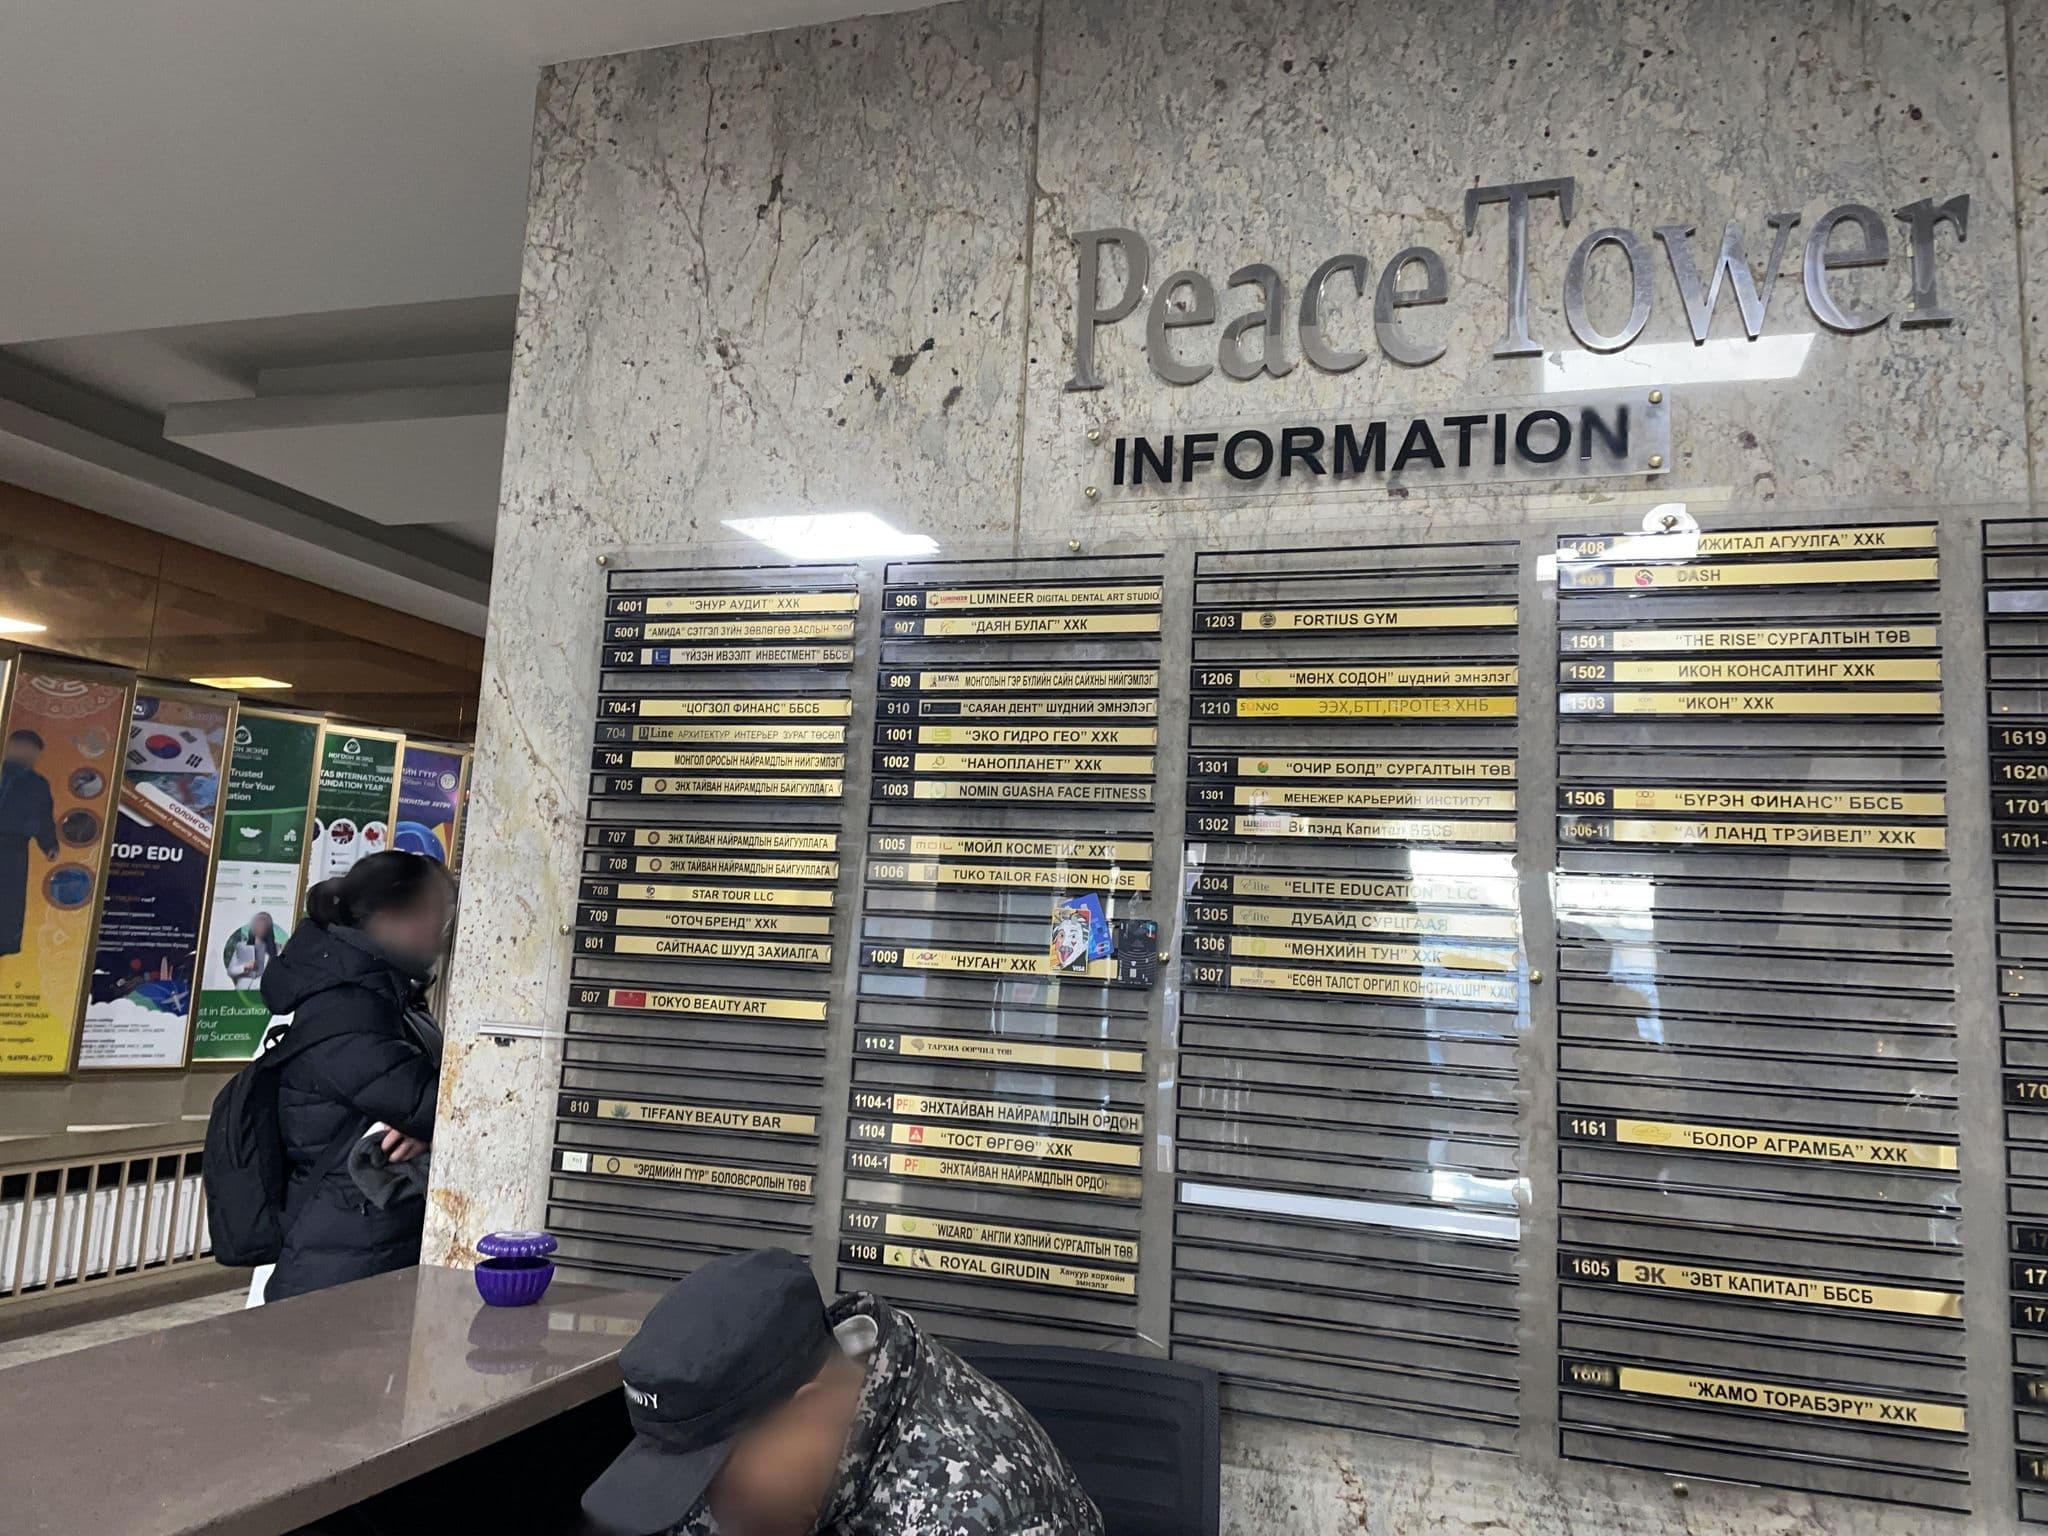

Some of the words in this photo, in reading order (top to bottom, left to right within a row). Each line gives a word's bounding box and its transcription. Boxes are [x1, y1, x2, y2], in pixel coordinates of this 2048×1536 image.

[1064, 229, 1449, 392] Peace
[1465, 177, 1970, 360] Tower
[1112, 405, 1631, 486] INFORMATION
[1853, 532, 1885, 546] ХХК
[1678, 570, 1720, 582] DASH
[617, 601, 642, 611] 4001
[777, 599, 800, 608] ХХК
[896, 595, 917, 606] 906
[970, 592, 1034, 604] LUMINEER
[1036, 594, 1068, 602] DIGITAL
[1106, 593, 1124, 601] ART
[1127, 592, 1159, 600] STUDIO
[1064, 619, 1087, 630] ХХК
[1205, 616, 1234, 627] 1203
[1294, 614, 1359, 626] FORTIUS
[1363, 613, 1397, 625] GYM
[614, 628, 639, 637] 5001
[1571, 635, 1605, 648] 1501
[1720, 633, 1765, 646] RISE”
[1768, 631, 1869, 646] СУРГАЛТЫН
[1876, 630, 1910, 644] ТӨВ
[614, 653, 633, 662] 702
[1201, 673, 1232, 685] 1206
[1289, 671, 1335, 684] “МӨНХ
[1338, 671, 1394, 685] СОДОН”
[1398, 671, 1450, 685] шүдний
[1455, 672, 1511, 684] эмнэлэг
[1569, 666, 1605, 679] 1502
[1679, 664, 1721, 677] ИКОН
[1728, 663, 1838, 678] КОНСАЛТИНГ
[1843, 663, 1874, 677] ХХК
[890, 676, 911, 687] 909
[609, 703, 636, 713] 704-1
[789, 703, 819, 712] ББСБ
[888, 703, 909, 714] 910
[1046, 701, 1094, 714] ШҮДНИЙ
[1097, 702, 1151, 712] ЭМНЭЛЭГ
[1200, 702, 1230, 714] 1210
[1570, 697, 1605, 710] 1503
[1678, 697, 1738, 709] “ИКОН”
[1743, 696, 1774, 709] ХХК
[606, 728, 625, 737] 704
[886, 729, 912, 740] 1001
[966, 730, 1000, 742] “ЭКО
[1003, 731, 1049, 744] ГИДРО
[1053, 731, 1087, 742] ГЕО”
[1091, 731, 1118, 742] ХХК
[2002, 731, 2046, 744] 1619
[605, 755, 623, 764] 704
[882, 756, 909, 768] 1002
[1075, 759, 1101, 771] ХХК
[231, 769, 263, 778] Trusted
[1198, 761, 1228, 772] 1301
[1286, 763, 1332, 774] “ОЧИР
[1336, 764, 1383, 776] БОЛД”
[1386, 764, 1473, 776] СУРГАЛТЫН
[1481, 765, 1510, 776] ТӨВ
[242, 781, 254, 789] for
[256, 783, 275, 791] Your
[365, 783, 383, 791] YEAR
[615, 780, 633, 790] 705
[675, 782, 691, 791] ЭНХ
[882, 785, 908, 796] 1003
[959, 785, 998, 796] NOMIN
[1002, 786, 1054, 797] GUASHA
[1058, 787, 1090, 798] FACE
[1094, 788, 1146, 799] FITNESS
[1200, 791, 1224, 800] 1301
[1284, 793, 1342, 804] МЕНЕЖЕР
[1347, 792, 1423, 805] КАРЬЕРИЙН
[1426, 795, 1492, 805] ИНСТИТУТ
[1565, 791, 1605, 805] 1506
[1751, 794, 1842, 810] ФИНАНС”
[1850, 796, 1903, 810] ББСБ
[169, 803, 210, 832] СОЛОНГОС
[1198, 819, 1229, 831] 1302
[608, 832, 626, 842] 707
[668, 833, 684, 844] ЭНХ
[1714, 826, 1767, 843] ЛАНД
[1772, 826, 1871, 843] ТРЭЙВЕЛ”
[1878, 830, 1915, 844] ХХК
[878, 838, 905, 850] 1005
[111, 844, 142, 858] TOP
[147, 846, 183, 861] EDU
[609, 859, 627, 869] 708
[670, 861, 685, 871] ЭНХ
[874, 865, 903, 877] 1006
[953, 869, 985, 881] TUKO
[989, 870, 1031, 882] TAILOR
[1034, 872, 1088, 884] FASHION
[592, 886, 609, 895] 708
[692, 890, 719, 899] STAR
[722, 891, 750, 900] TOUR
[753, 892, 774, 901] LLC
[1285, 881, 1335, 895] “ELITE
[590, 911, 608, 920] 709
[755, 919, 777, 928] ХХК
[1193, 908, 1228, 921] 1305
[1292, 911, 1357, 928] ДУБАЙД
[585, 938, 603, 948] 801
[656, 939, 718, 954] САЙТНААС
[722, 943, 754, 957] ШУУД
[758, 946, 818, 959] ЗАХИАЛГА
[1193, 938, 1224, 950] 1306
[1413, 950, 1441, 962] ХХК
[871, 951, 897, 963] 1009
[951, 955, 1007, 969] “НУГАН”
[1010, 958, 1036, 971] ХХК
[1195, 968, 1223, 981] 1307
[1327, 976, 1360, 988] ТАЛСТ
[1363, 977, 1400, 991] ОРГИЛ
[581, 991, 600, 1002] 807
[651, 996, 690, 1009] TOKYO
[694, 999, 740, 1012] BEAUTY
[743, 1002, 766, 1013] ART
[210, 1007, 218, 1015] in
[210, 1032, 251, 1042] Success.
[865, 1038, 894, 1049] 1102
[571, 1102, 589, 1113] 810
[641, 1107, 693, 1122] TIFFANY
[696, 1111, 748, 1126] BEAUTY
[752, 1116, 781, 1129] BAR
[855, 1096, 891, 1108] 1104-1
[920, 1101, 994, 1119] ЭНХТАЙВАН
[1092, 1116, 1138, 1130] ОРДОН
[858, 1124, 885, 1137] 1104
[941, 1134, 982, 1147] “ТОСТ
[1046, 1144, 1072, 1156] ХХК
[1572, 1120, 1606, 1136] 1161
[1683, 1130, 1758, 1149] “БОЛОР
[1764, 1138, 1864, 1158] АГРАМБА”
[1870, 1145, 1908, 1162] ХХК
[852, 1156, 888, 1168] 1104-1
[940, 1161, 998, 1179] ЭНХТАЙВАН
[788, 1179, 806, 1191] ТӨВ
[848, 1215, 878, 1228] 1107
[981, 1230, 1011, 1242] АНГЛИ
[1014, 1232, 1050, 1248] ХЭЛНИЙ
[1054, 1238, 1111, 1256] СУРГАЛТЫН
[1114, 1245, 1133, 1258] ТӨВ
[850, 1247, 876, 1260] 1108
[940, 1256, 986, 1272] ROYAL
[990, 1262, 1050, 1280] GIRUDIN
[1572, 1260, 1609, 1276] 1605
[1682, 1270, 1724, 1288] “ЭВТ
[1729, 1274, 1817, 1299] КАПИТАЛ”
[1824, 1286, 1873, 1304] ББСБ
[1689, 1381, 1757, 1403] “ЖАМО
[1880, 1405, 1917, 1422] ХХК
